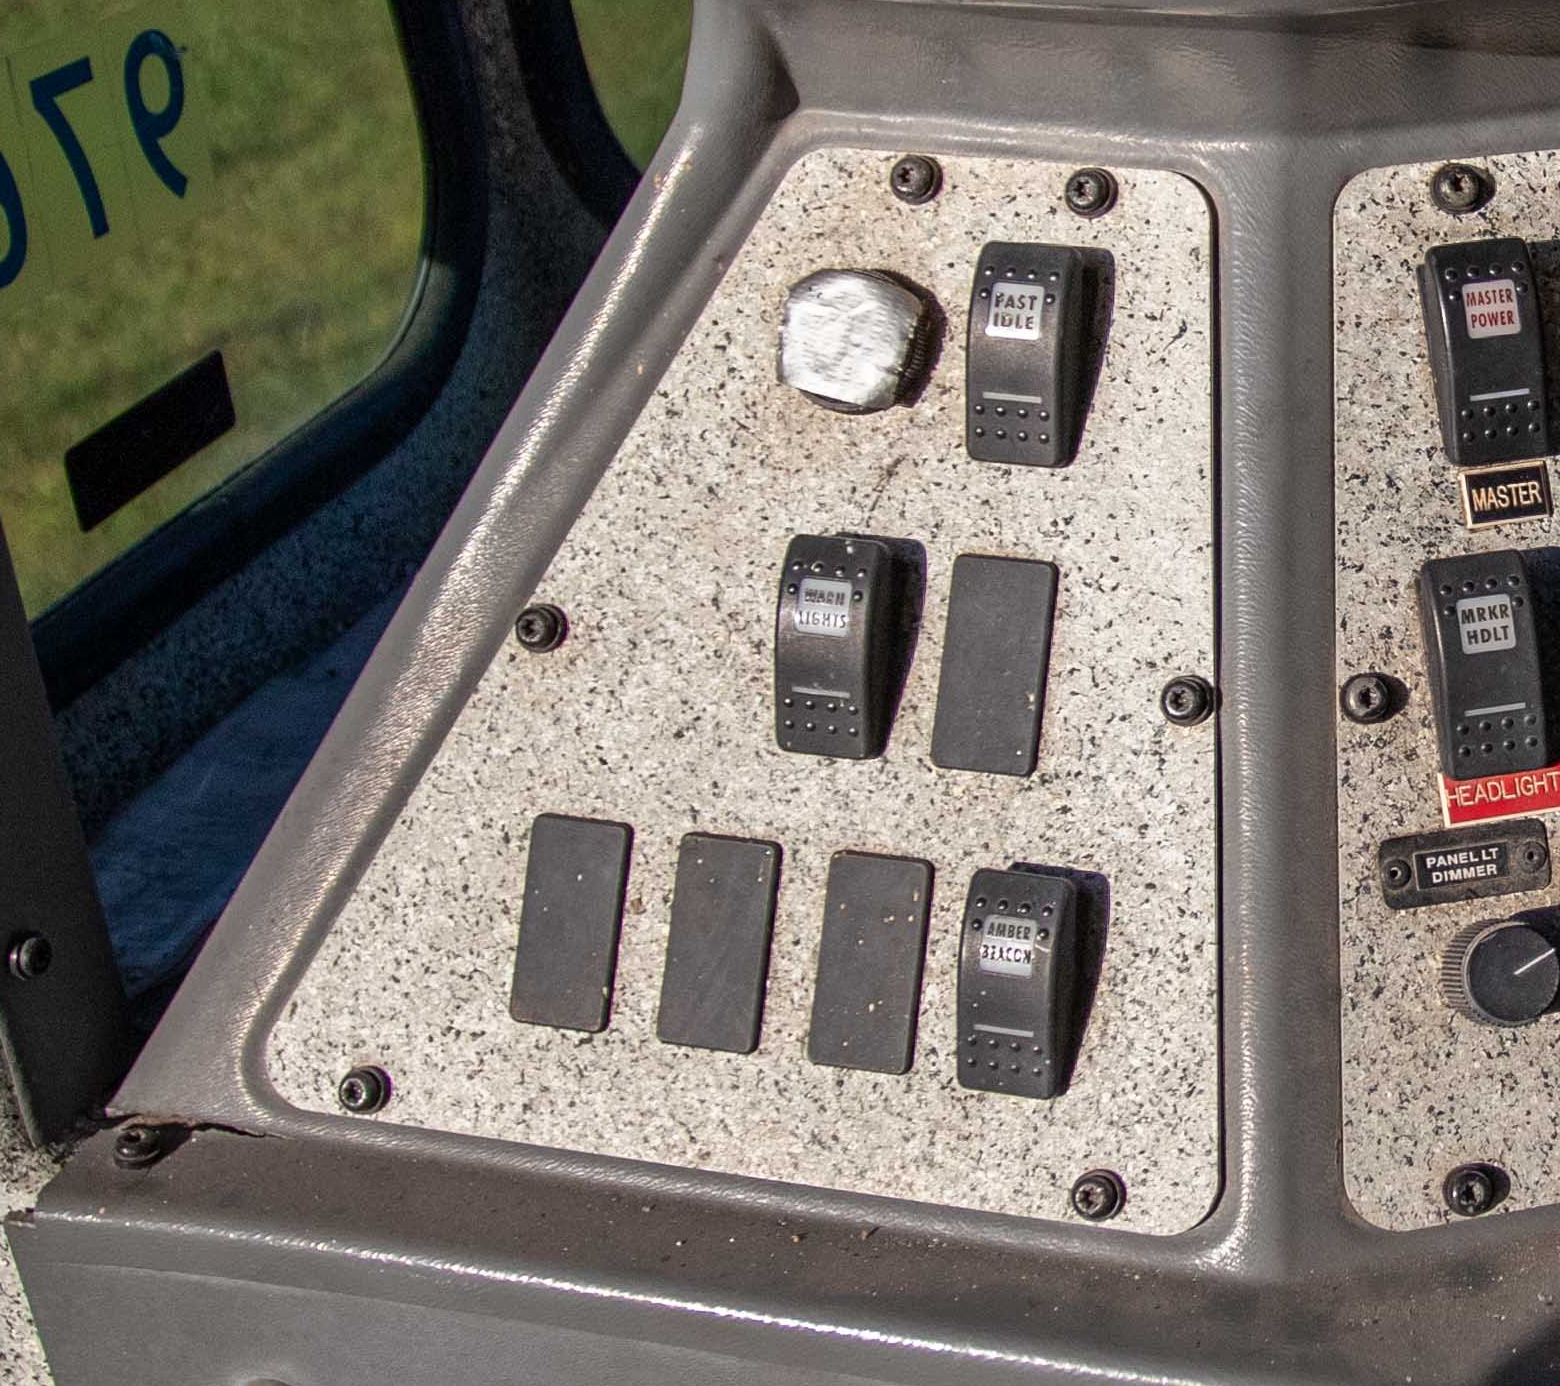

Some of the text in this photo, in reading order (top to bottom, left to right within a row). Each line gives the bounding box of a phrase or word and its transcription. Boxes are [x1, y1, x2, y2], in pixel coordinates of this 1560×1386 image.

[994, 293, 1038, 311] FAST
[1466, 288, 1514, 308] MASTER
[993, 312, 1035, 330] IDLE
[1471, 310, 1516, 329] POWER
[1471, 481, 1542, 512] MASTER
[799, 610, 847, 629] LIGHTS
[1461, 603, 1511, 625] MRKR
[1466, 625, 1510, 647] HDLT
[1425, 847, 1500, 869] PANEL LT
[1431, 863, 1498, 884] DIMMER
[987, 921, 1032, 940] AMBER
[981, 944, 1032, 964] BEACON
